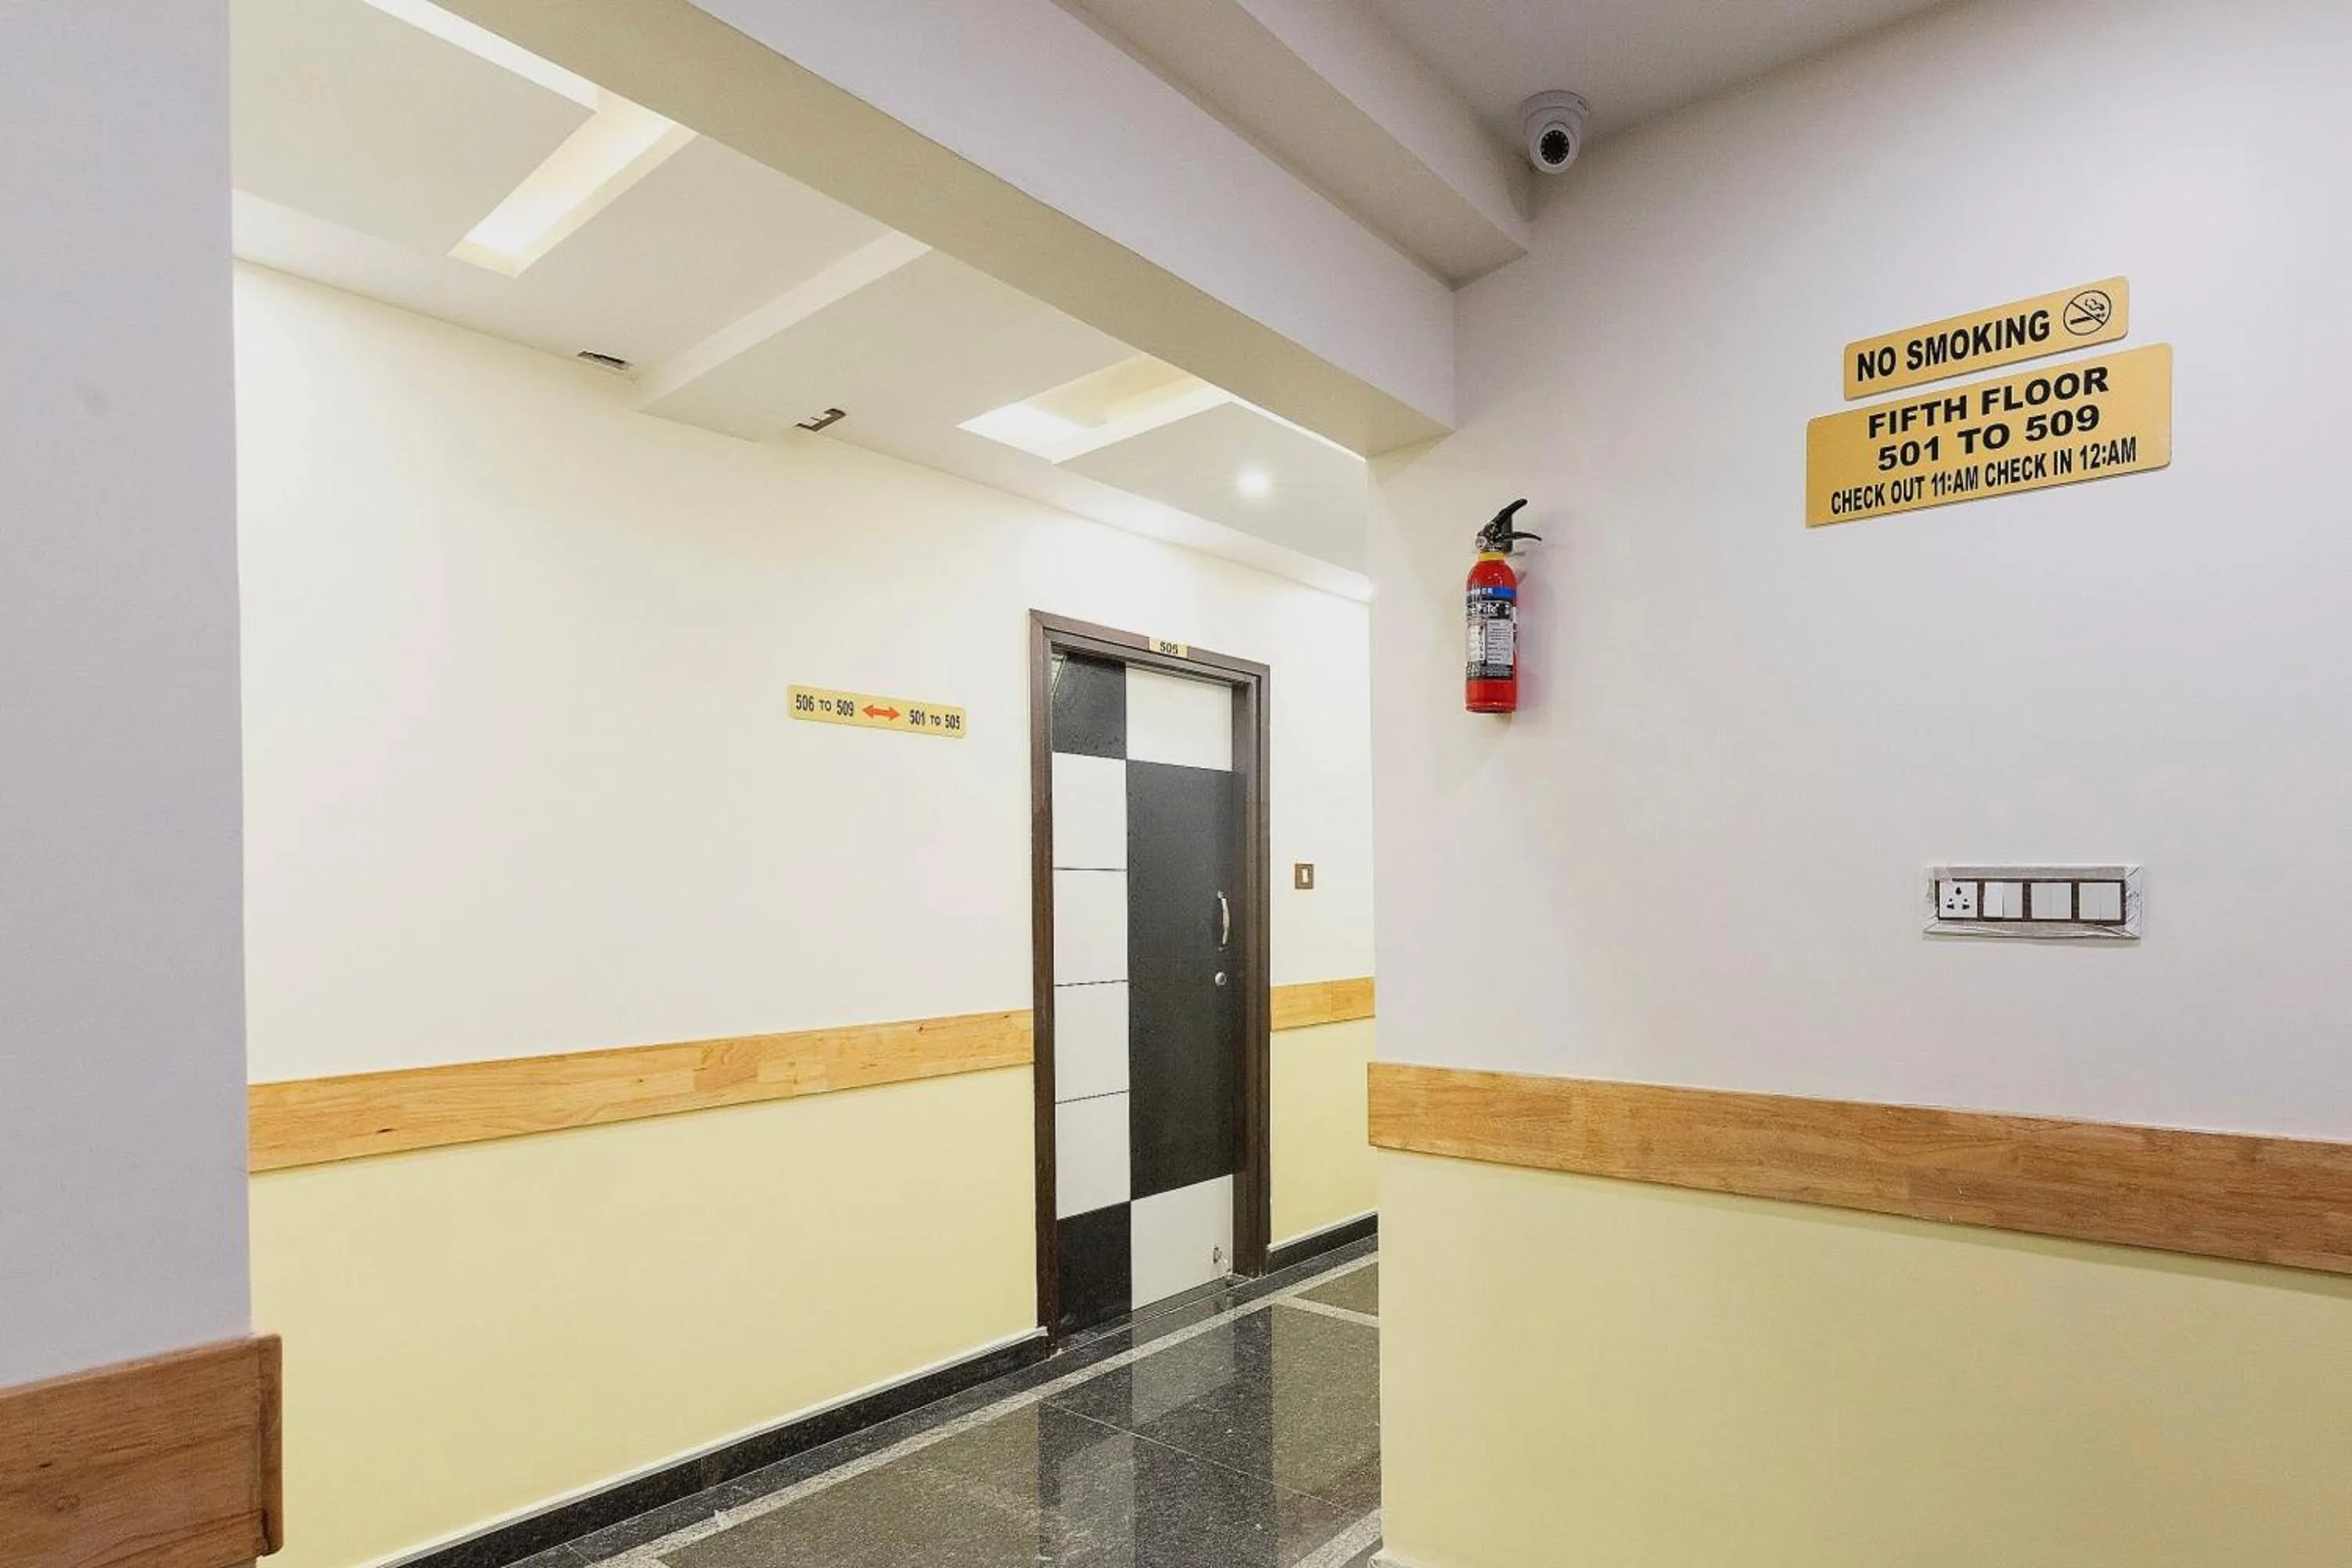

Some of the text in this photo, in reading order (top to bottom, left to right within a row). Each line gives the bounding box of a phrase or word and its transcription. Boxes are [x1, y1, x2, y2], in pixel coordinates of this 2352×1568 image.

[1857, 310, 2050, 382] NO SMOKING
[1869, 366, 2109, 439] FIFTH FLOOR
[1878, 405, 2100, 471] 501 TO 509
[1831, 436, 2136, 515] CHECK OUT 11:AM CHECK IN 12:AM
[796, 694, 960, 729] 506 TO 509 501 TO 505
